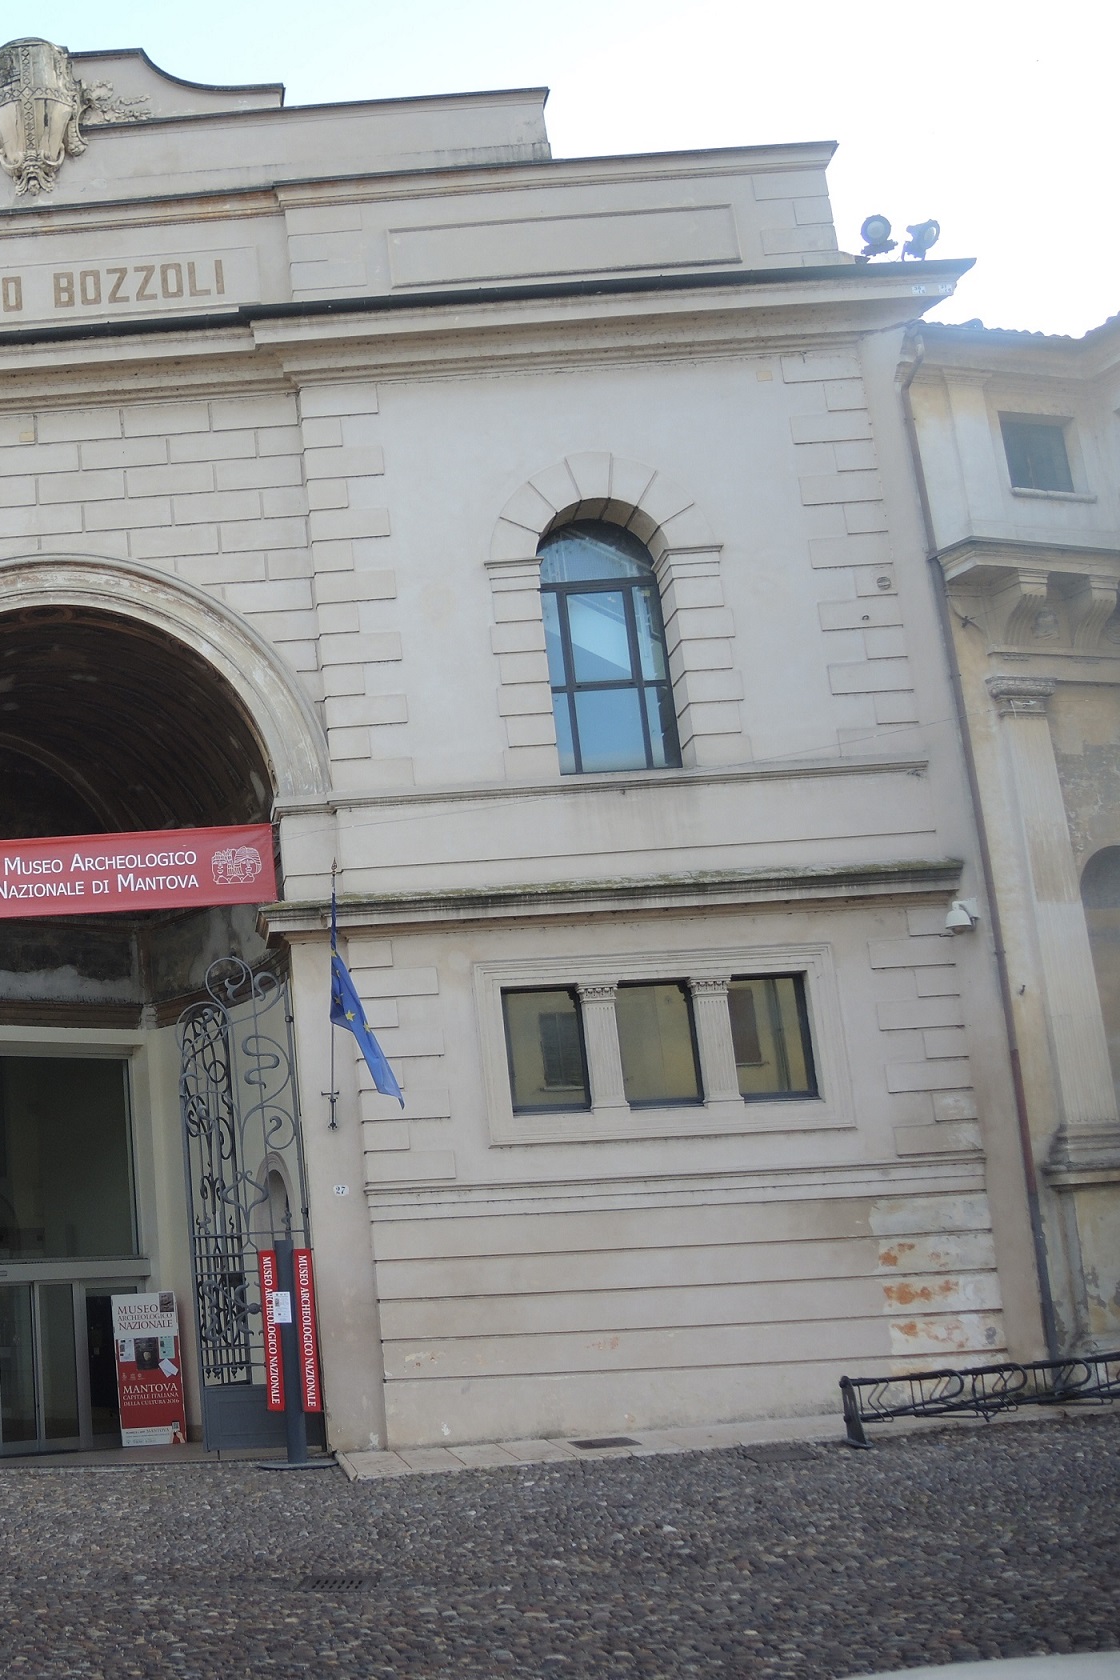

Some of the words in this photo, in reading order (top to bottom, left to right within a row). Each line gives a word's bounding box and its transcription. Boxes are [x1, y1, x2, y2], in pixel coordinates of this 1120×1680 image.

[53, 259, 225, 308] BOZZOLI
[4, 856, 63, 876] MUSEO
[70, 851, 197, 872] ARCHEOLOGICO
[92, 880, 110, 894] DI
[117, 873, 199, 892] MANTOVA
[335, 1186, 346, 1195] 27
[263, 1256, 273, 1286] MUSEO
[298, 1255, 309, 1286] MUSEO
[118, 1304, 159, 1315] MUSEO
[118, 1313, 173, 1321] ARCHEOLOGICO
[265, 1287, 278, 1355] ARCHEOLOGICO
[300, 1287, 314, 1356] ARCHEOLOGICO
[119, 1320, 173, 1330] NAZIONALE
[123, 1383, 178, 1394] MANTOVA
[269, 1356, 281, 1404] NAZIONALE
[305, 1357, 317, 1407] NAZIONALE
